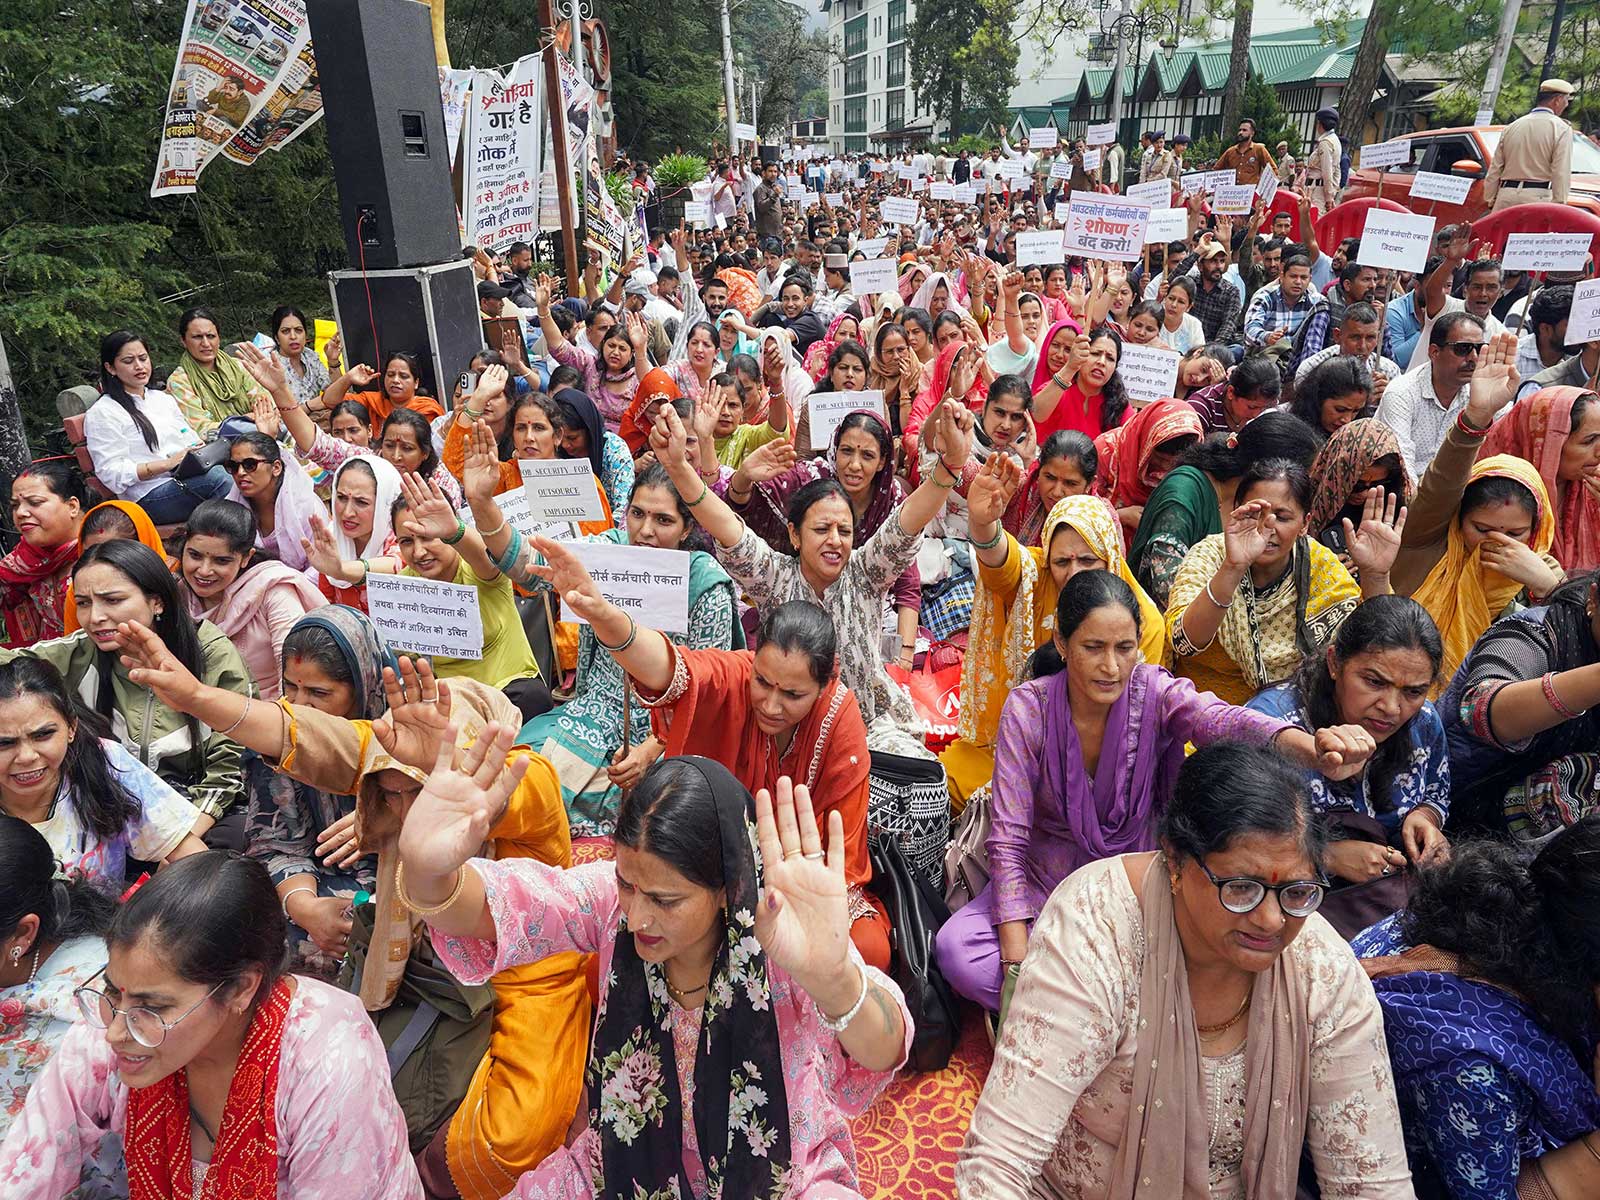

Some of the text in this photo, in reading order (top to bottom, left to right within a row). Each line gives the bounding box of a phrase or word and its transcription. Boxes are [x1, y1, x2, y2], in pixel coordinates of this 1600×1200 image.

[274, 3, 294, 20] LIMIT
[519, 100, 532, 124] है
[1071, 204, 1104, 216] आउटसोर्स
[1105, 206, 1140, 220] कर्मचारियों
[1138, 211, 1148, 220] का
[1085, 217, 1130, 236] शोषण
[1078, 234, 1132, 252] बंद करो!
[535, 466, 569, 474] SECURITY
[573, 465, 590, 473] FOR
[538, 487, 580, 496] OUTSOURCE
[544, 506, 586, 516] EMPLOYEES
[611, 570, 651, 585] कर्मचारी
[654, 575, 682, 586] एकता
[368, 579, 474, 603] आउटसोर्स कर्मचारियों को मृत्यु
[374, 600, 467, 618] अथवा स्थायी दिव्यांगता की
[376, 618, 398, 629] स्थिति
[408, 622, 432, 634] आश्रित
[433, 626, 444, 635] को
[447, 626, 468, 638] उचित
[402, 640, 413, 650] एवं
[414, 640, 440, 654] रोजगार
[441, 644, 458, 656] दिया
[922, 718, 957, 740] Aqu
